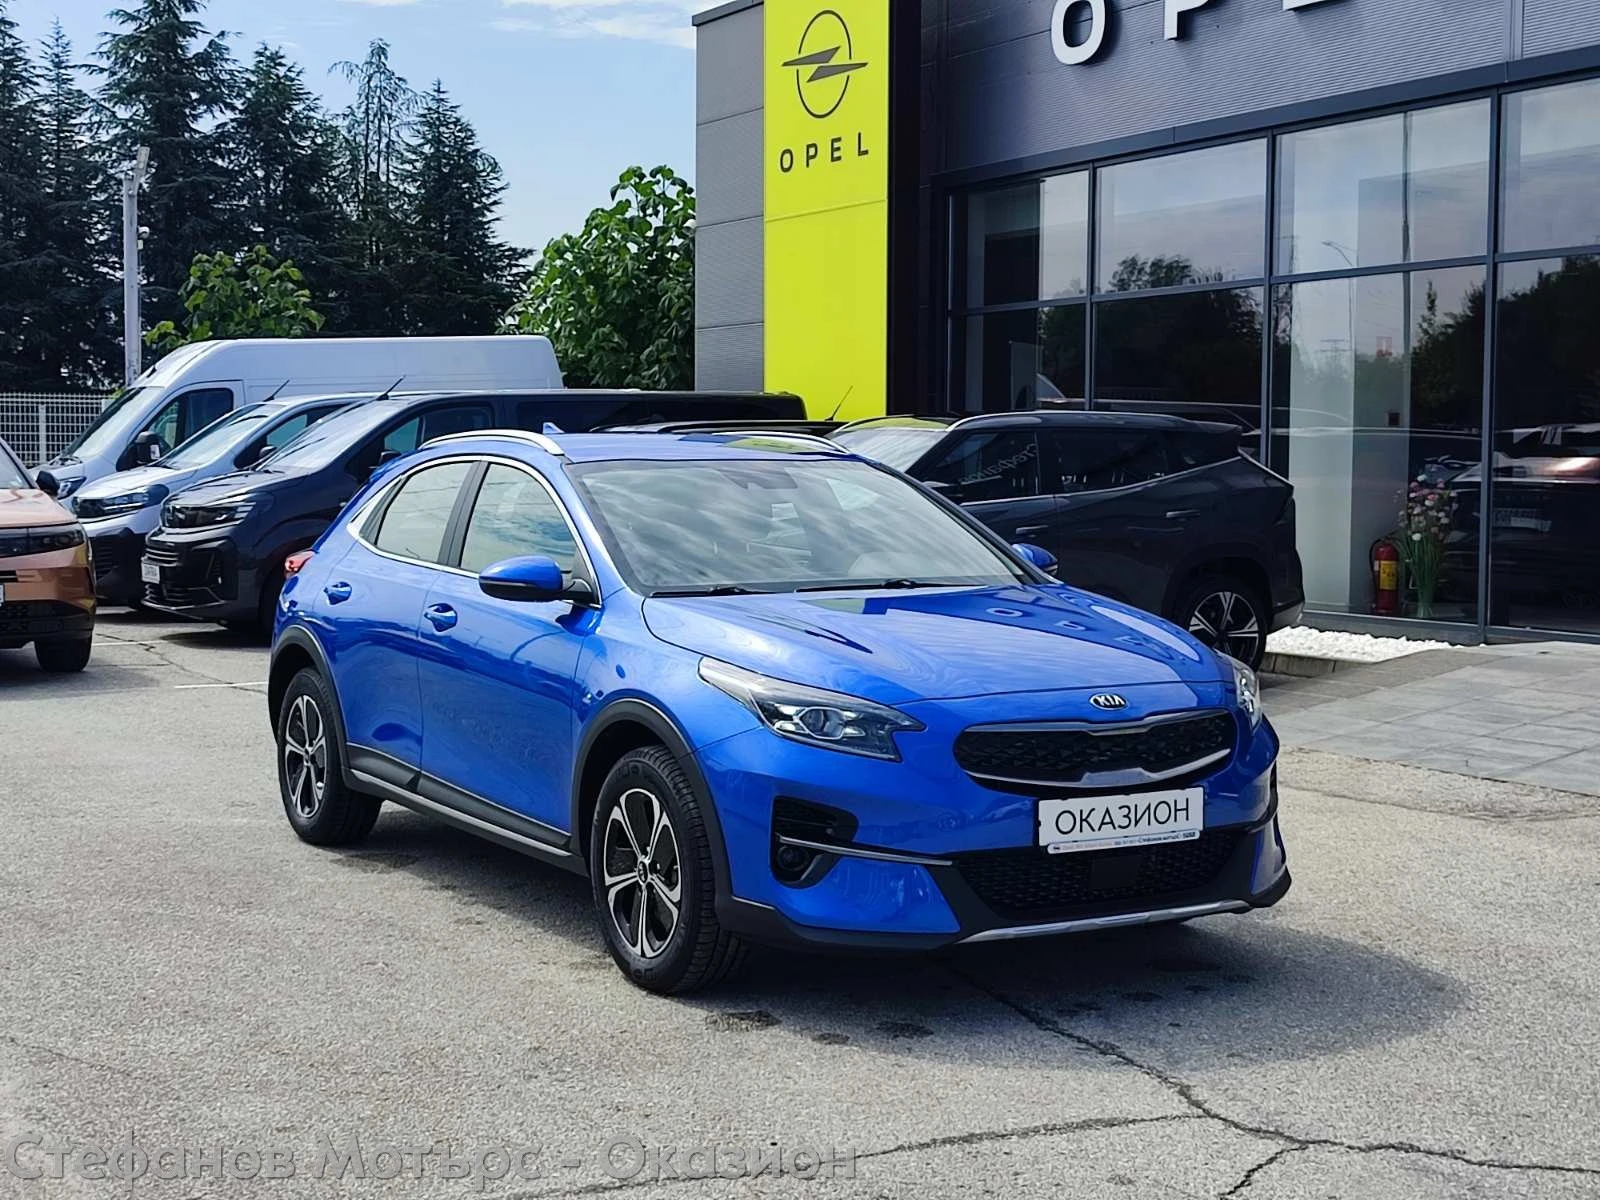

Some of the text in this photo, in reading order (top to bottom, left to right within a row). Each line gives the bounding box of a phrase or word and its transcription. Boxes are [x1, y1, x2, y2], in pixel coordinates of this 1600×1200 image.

[780, 132, 869, 173] OPEL
[1093, 694, 1125, 706] KIA
[1055, 798, 1190, 835] ОКАЗИОН
